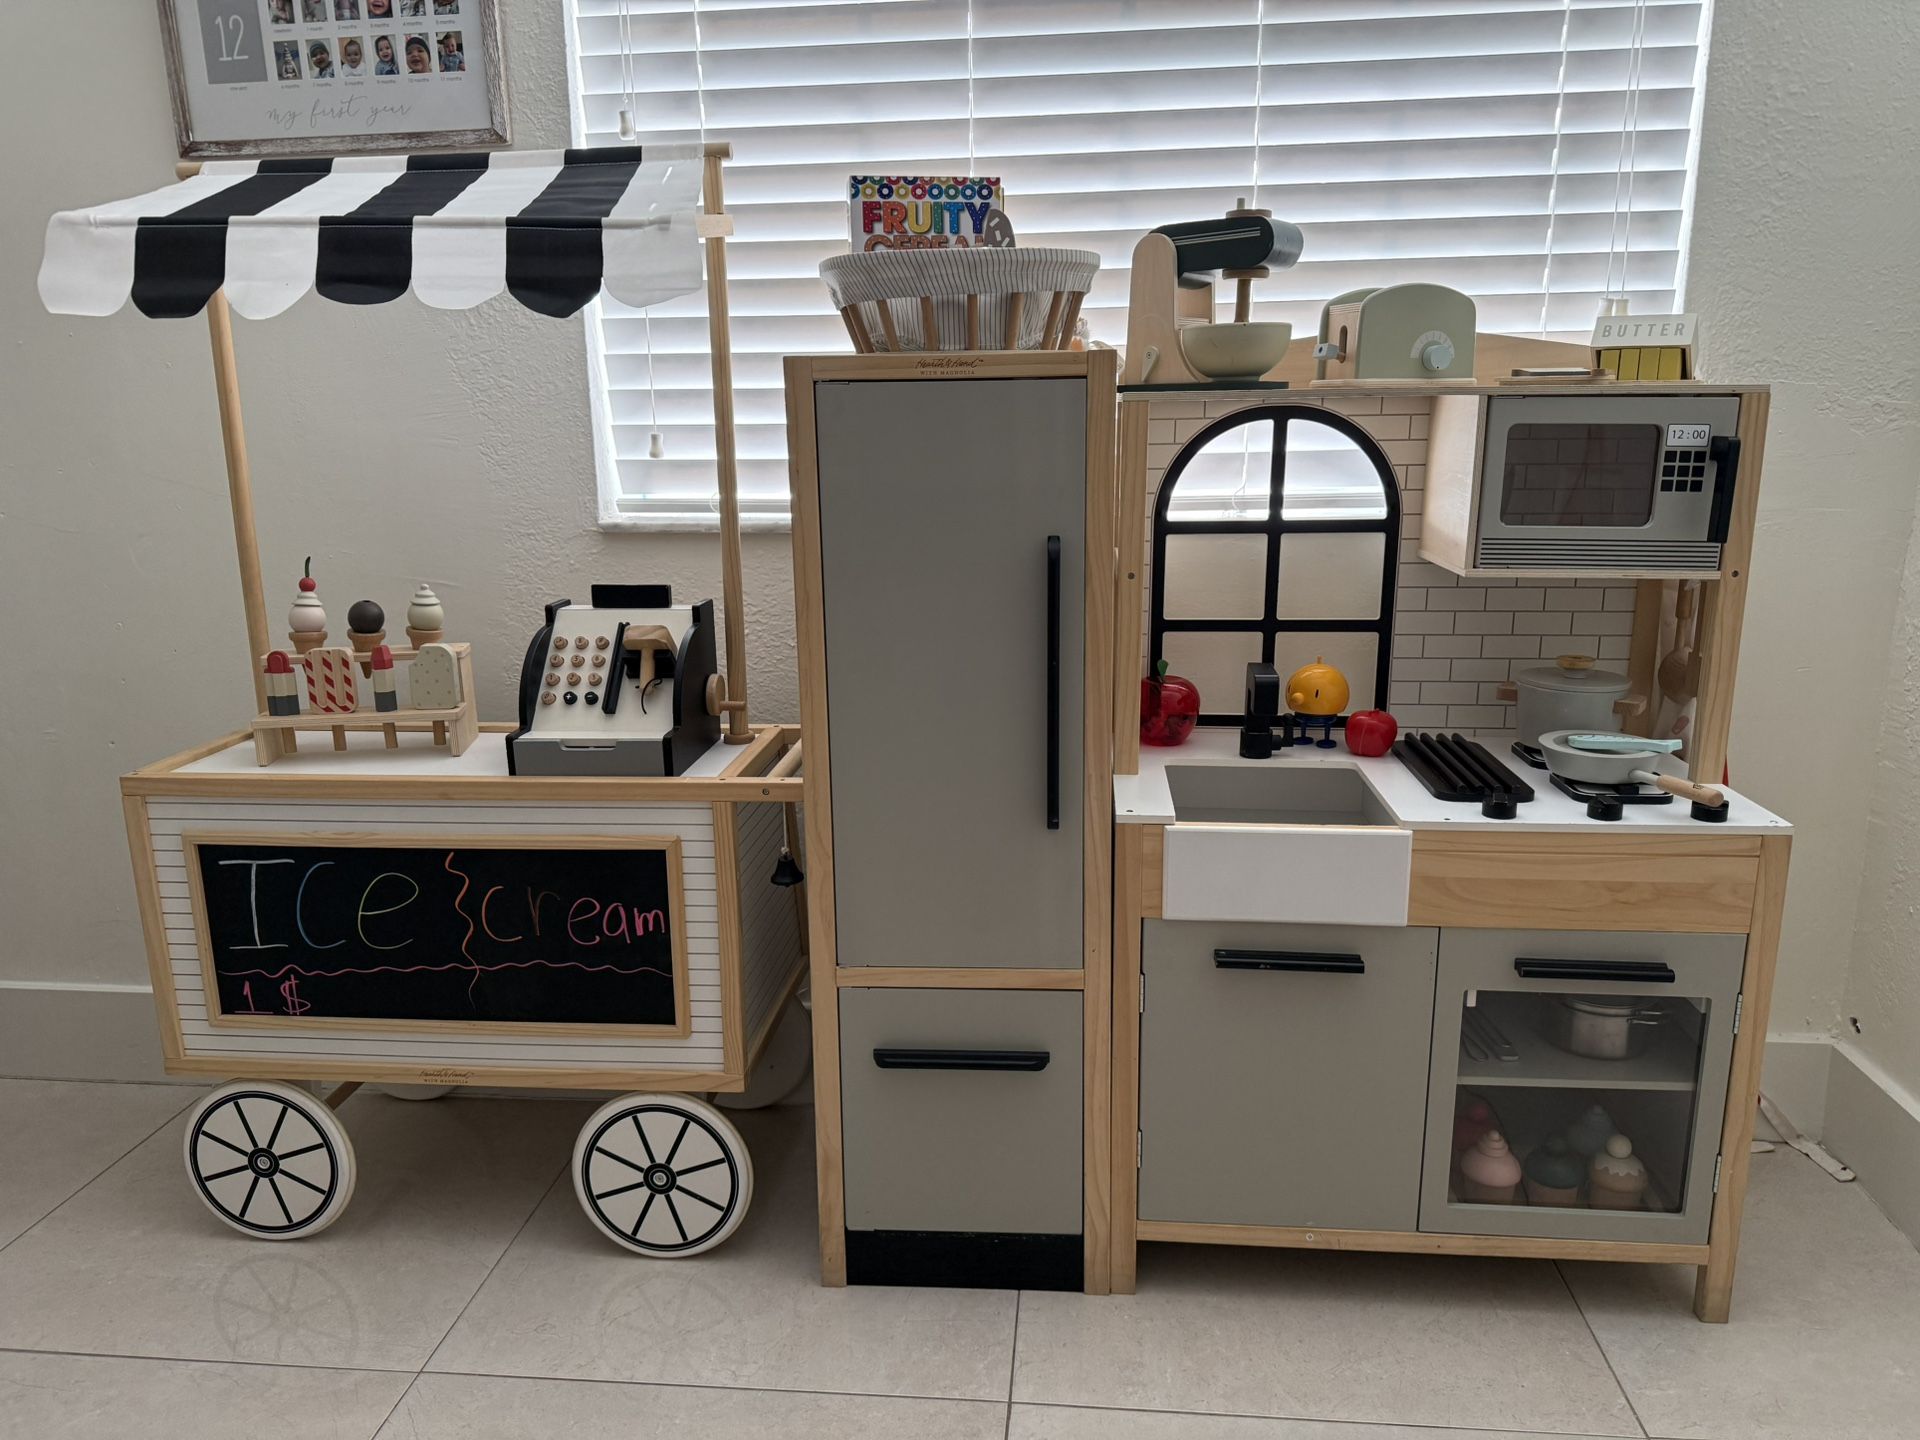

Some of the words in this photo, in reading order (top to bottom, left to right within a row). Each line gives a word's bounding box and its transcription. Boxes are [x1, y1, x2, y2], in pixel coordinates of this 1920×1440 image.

[215, 14, 249, 61] 12
[266, 108, 302, 130] my
[310, 94, 368, 128] first
[365, 104, 413, 127] year
[862, 200, 991, 234] FRUITY
[1601, 322, 1686, 338] BUTTER
[1671, 429, 1707, 441] 12:00
